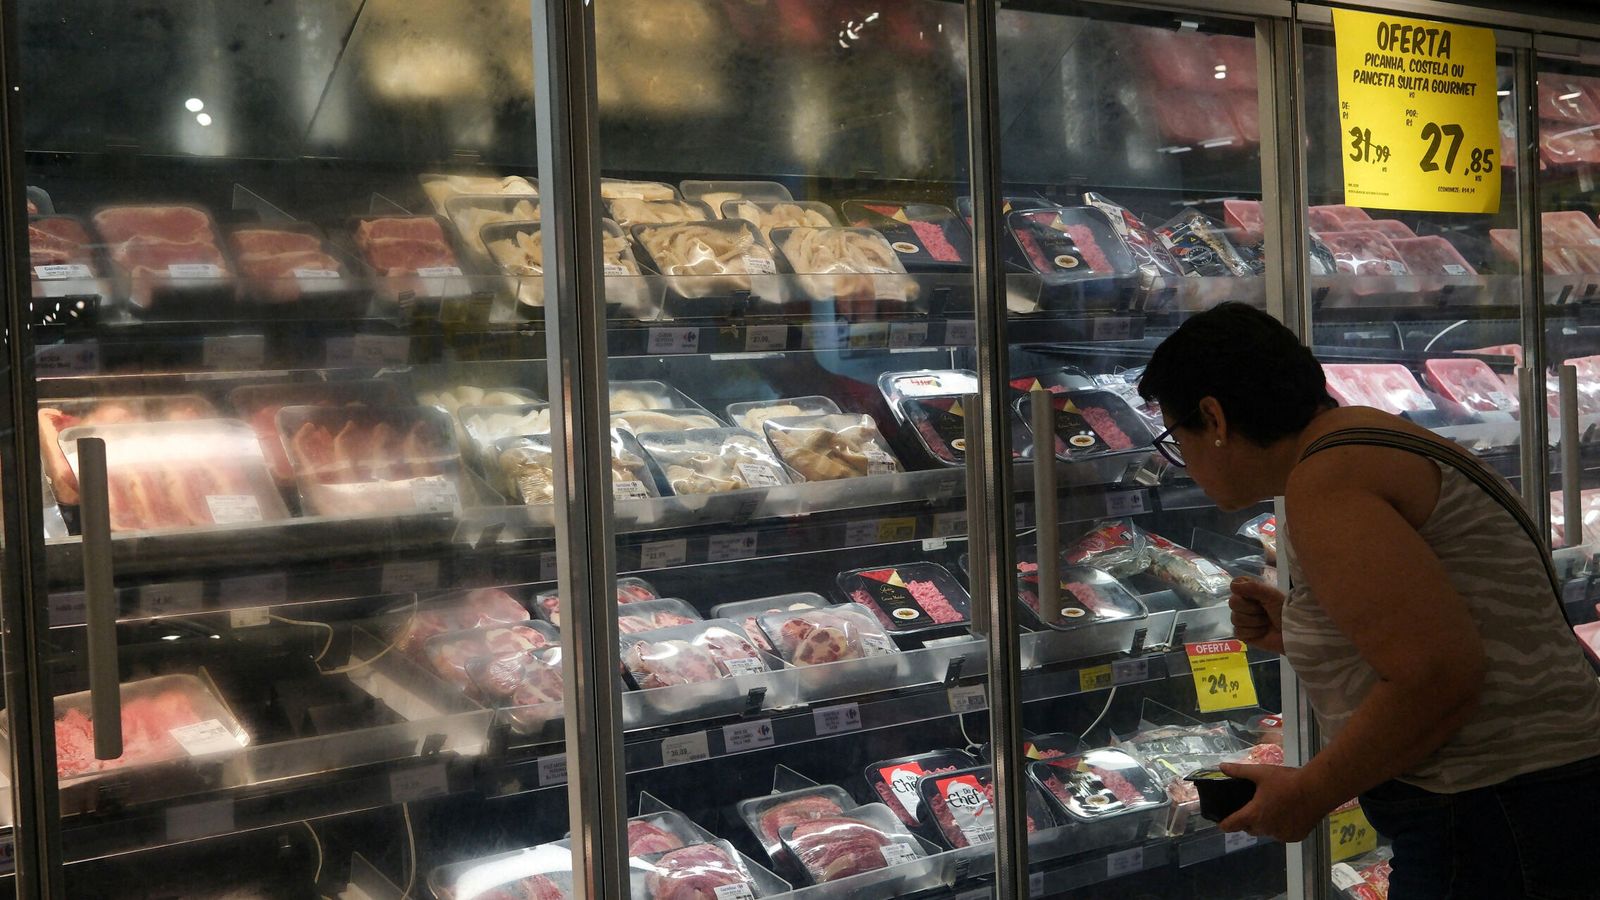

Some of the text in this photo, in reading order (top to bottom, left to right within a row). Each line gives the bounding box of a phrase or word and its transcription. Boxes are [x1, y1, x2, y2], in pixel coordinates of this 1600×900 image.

[1376, 21, 1452, 59] OFERTA
[1364, 52, 1464, 78] PICANHA, COSTELA OU
[1353, 69, 1477, 97] PANCETA SULITA GOURMET
[1405, 109, 1418, 118] POR:
[1419, 122, 1494, 176] 27,85
[1195, 642, 1231, 654] OFERTA
[1208, 673, 1239, 695] 24,99
[947, 788, 981, 808] Chef
